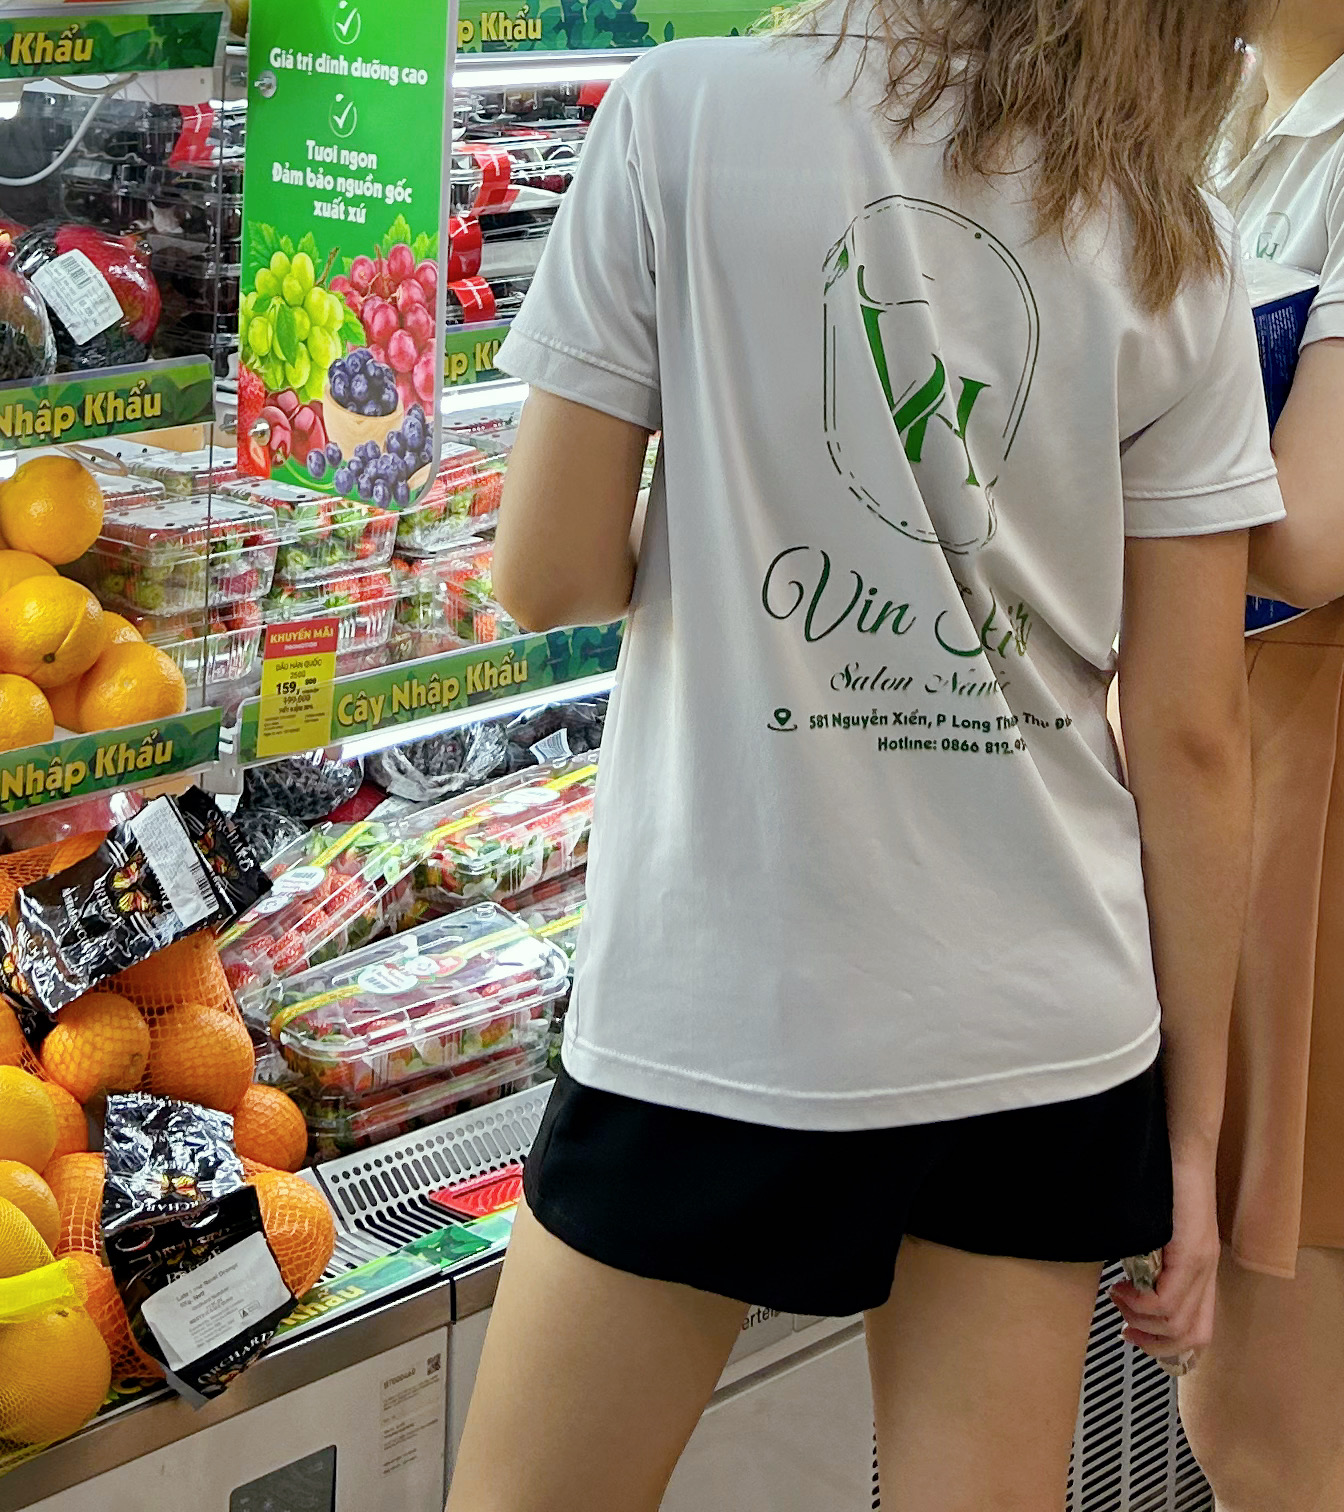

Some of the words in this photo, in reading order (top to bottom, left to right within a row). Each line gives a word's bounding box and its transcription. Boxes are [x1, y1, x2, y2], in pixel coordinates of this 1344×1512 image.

[9, 22, 95, 68] Khẩu
[480, 6, 543, 43] Khẩu
[269, 46, 294, 68] Giá
[295, 52, 314, 77] trị
[315, 53, 349, 79] dinh
[401, 67, 429, 87] cao
[340, 149, 378, 171] ngon
[271, 160, 311, 189] Đảm
[312, 165, 335, 192] bảo
[384, 177, 414, 206] gốc
[312, 195, 346, 222] xuất
[83, 382, 163, 426] Khẩu
[762, 545, 917, 642] Vin
[337, 683, 387, 731] Cây
[390, 666, 460, 716] Nhập
[465, 650, 528, 692] Khẩu
[830, 661, 914, 692] Salon
[809, 713, 829, 730] 581
[831, 707, 888, 730] Nguyễn
[936, 713, 947, 727] P
[952, 714, 991, 733] Long
[1, 756, 87, 802] Nhập
[94, 729, 174, 779] Khẩu
[877, 736, 937, 752] Hotline:
[941, 738, 979, 754] 0866
[206, 808, 253, 873] ORCHARD
